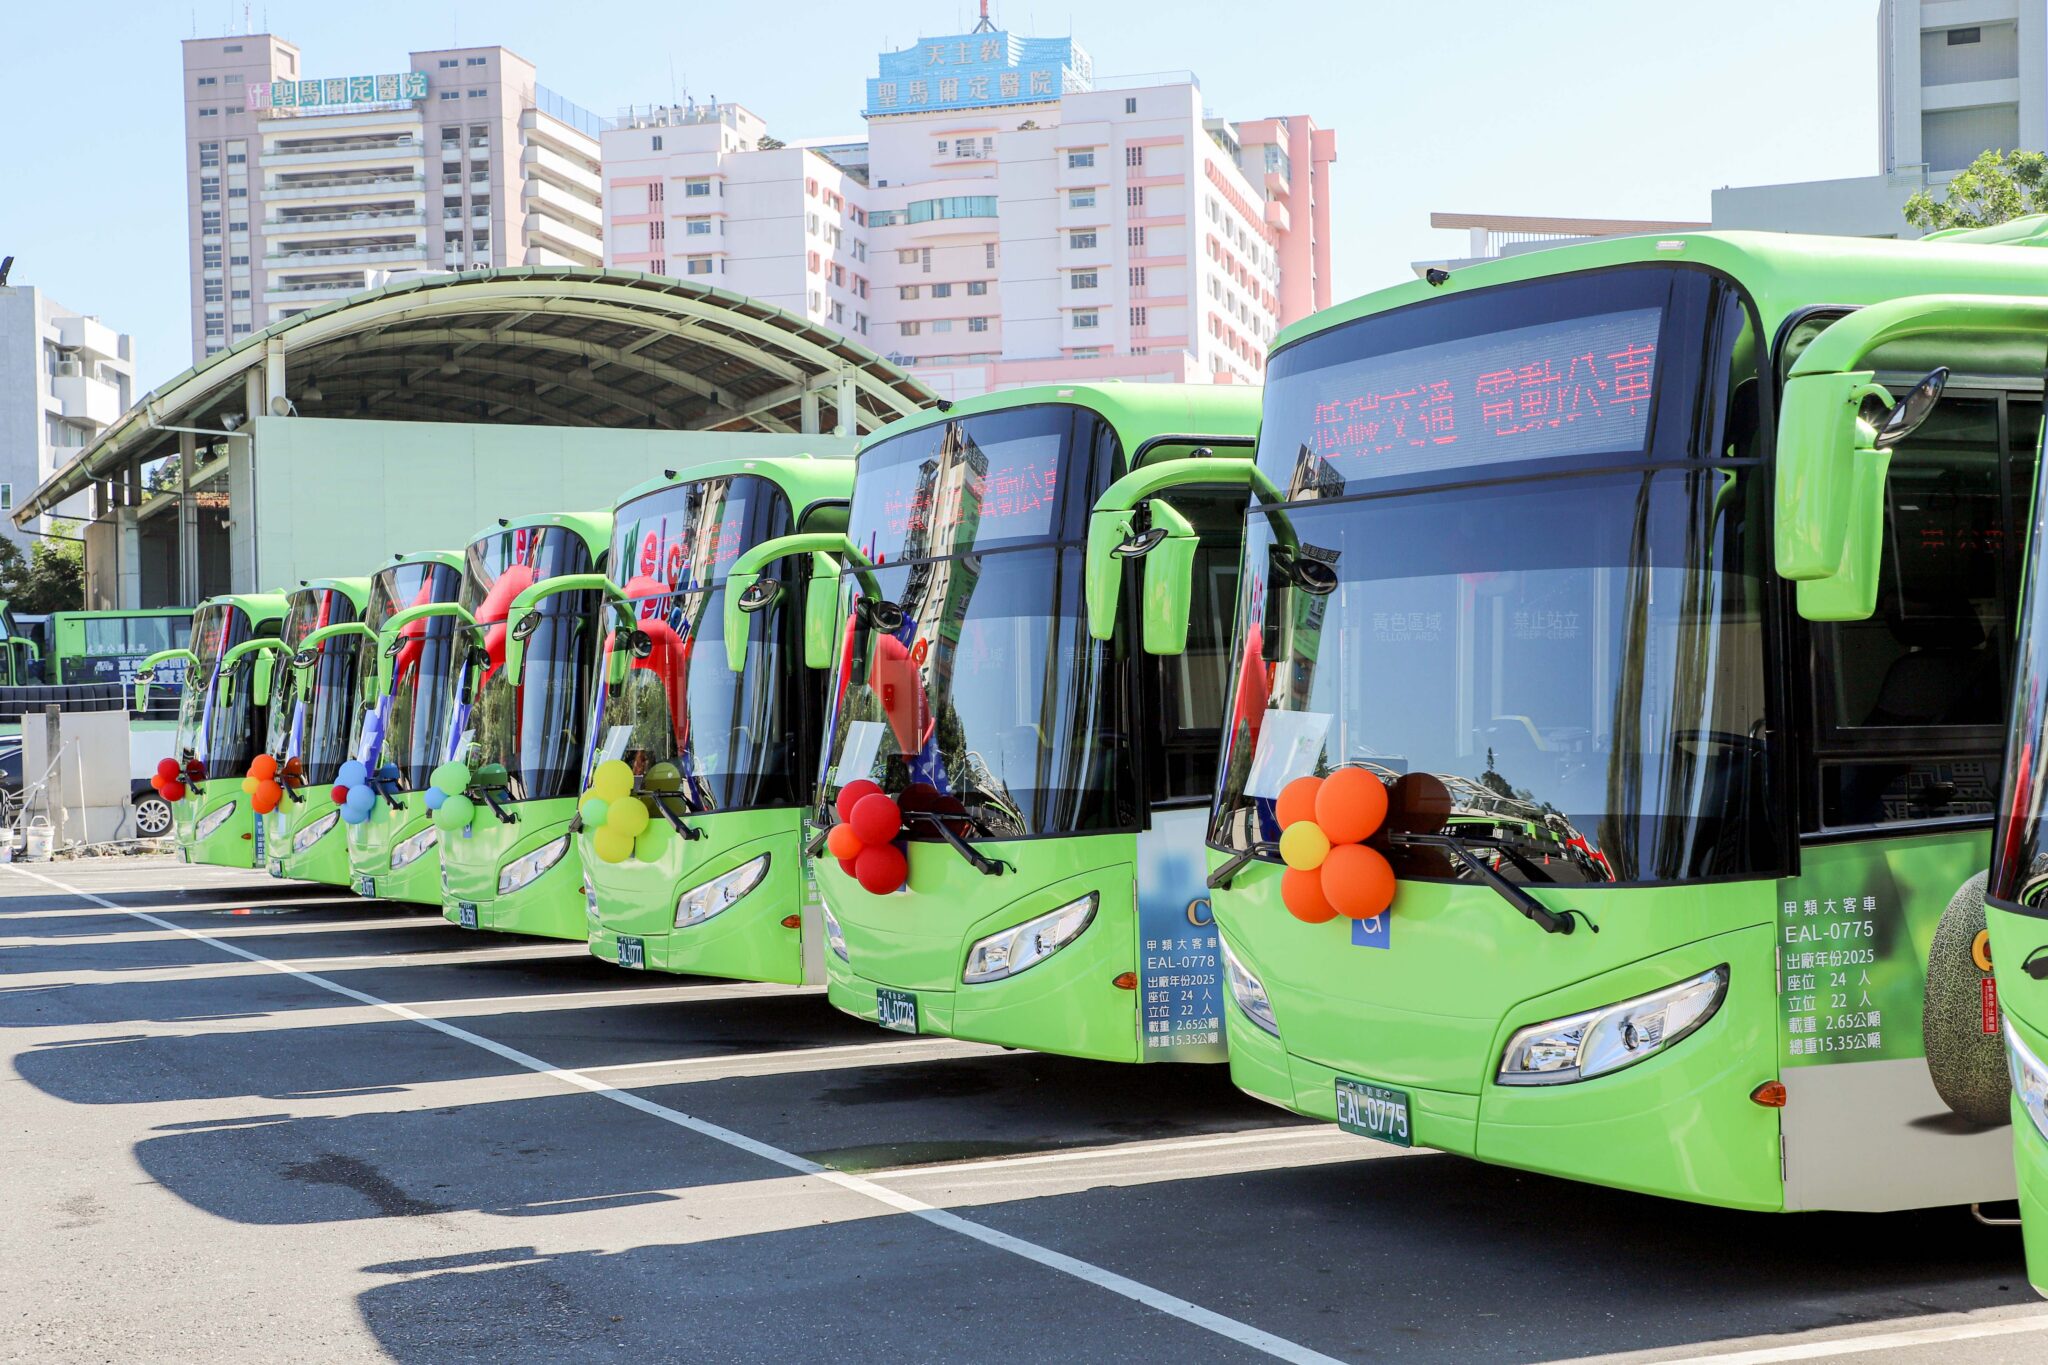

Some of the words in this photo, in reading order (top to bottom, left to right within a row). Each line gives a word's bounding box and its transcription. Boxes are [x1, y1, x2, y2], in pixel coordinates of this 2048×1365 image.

[926, 38, 1002, 66] 天主教
[274, 72, 427, 107] 聖馬爾定醫院
[878, 70, 1054, 108] 聖馬爾定醫院
[1372, 611, 1442, 632] 黃色區域
[1513, 610, 1580, 631] 禁止站立
[1375, 631, 1411, 643] YELLOW
[1414, 631, 1440, 642] AREA
[1784, 895, 1877, 918] 甲類大客車
[1785, 920, 1875, 943] EAL-0775
[1146, 937, 1217, 952] 甲類大客車
[1147, 955, 1216, 970] EAL-0778
[1786, 948, 1875, 970] 出廠年份2025
[1147, 974, 1216, 989] 出廠年份2025
[1787, 973, 1816, 992] 座位
[1829, 972, 1847, 988] 24
[1858, 969, 1872, 987] 人
[1148, 991, 1170, 1003] 座位
[1180, 990, 1194, 1001] 24
[1201, 988, 1213, 1001] 人
[1787, 994, 1817, 1013] 立位
[1830, 993, 1848, 1009] 22
[1859, 990, 1873, 1008] 人
[877, 996, 916, 1027] EAL-0778
[1148, 1006, 1170, 1018] 立位
[1180, 1005, 1194, 1016] 22
[1202, 1003, 1213, 1015] 人
[1788, 1015, 1817, 1034] 載重
[1825, 1010, 1882, 1031] 2.65公噸
[1148, 1020, 1170, 1033] 載重
[1336, 1089, 1408, 1138] EAL-0775
